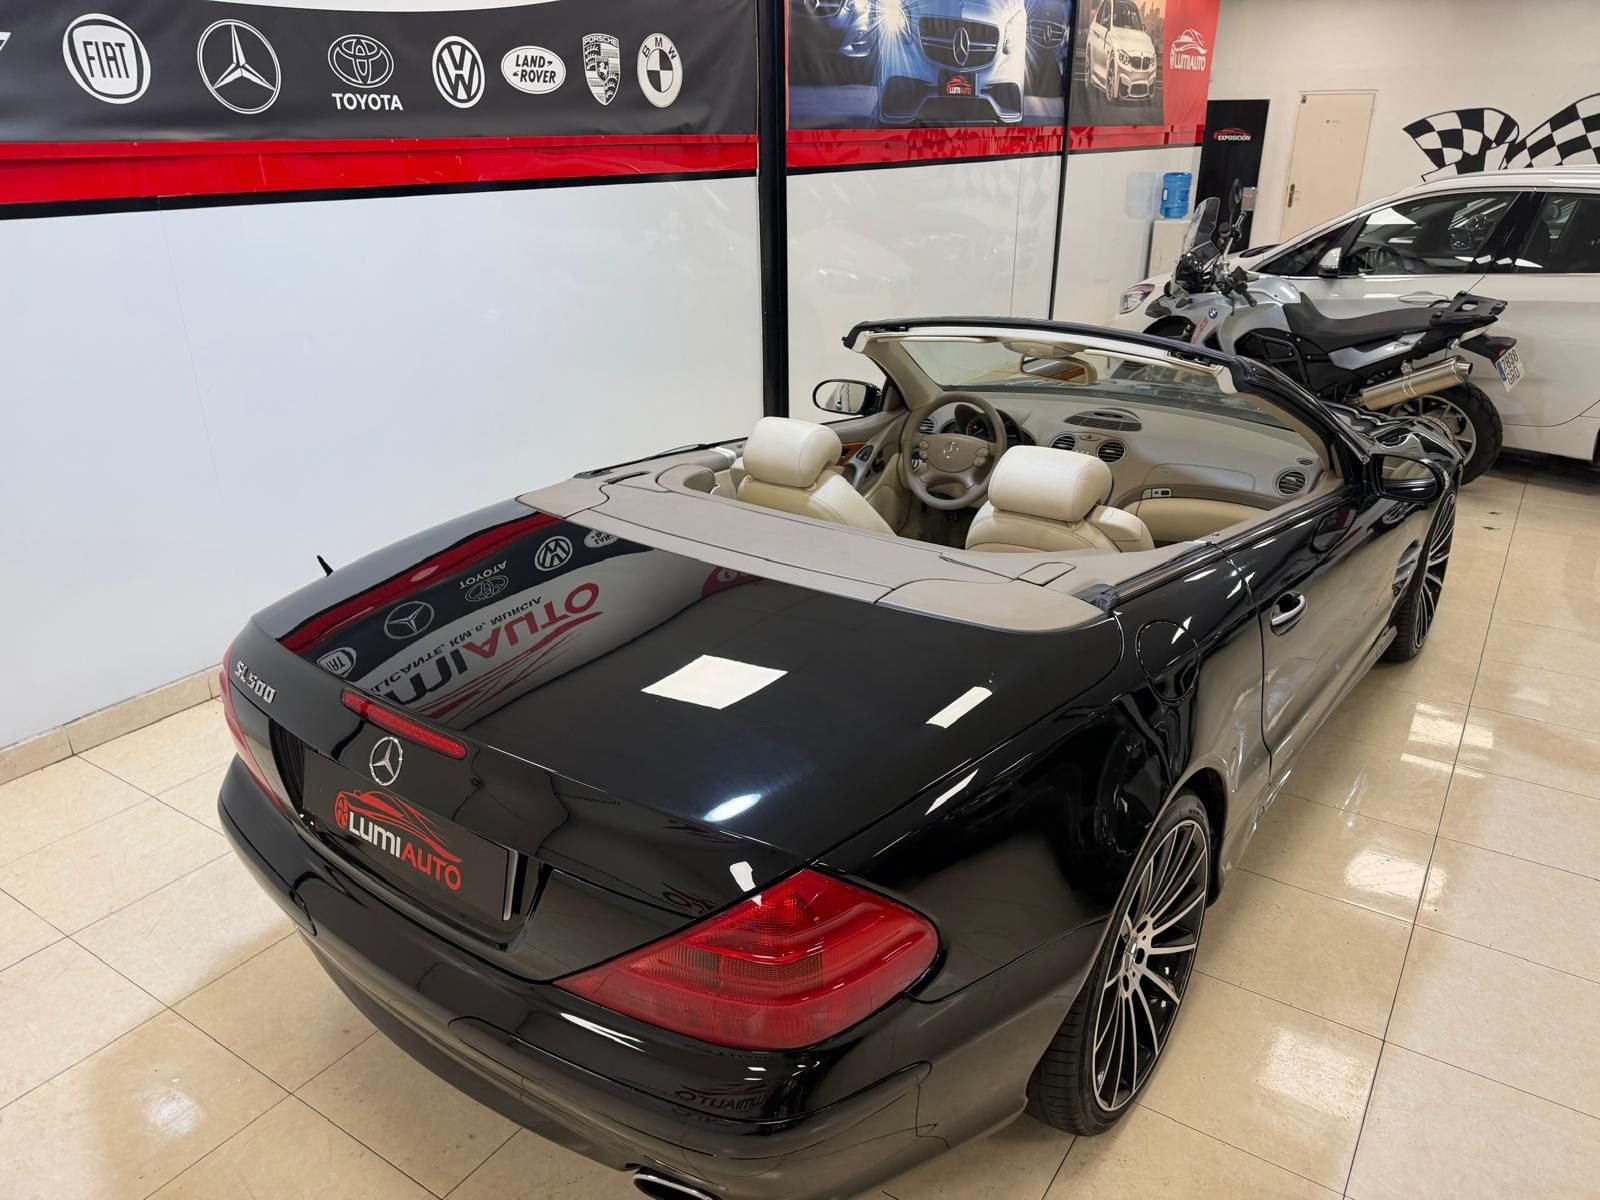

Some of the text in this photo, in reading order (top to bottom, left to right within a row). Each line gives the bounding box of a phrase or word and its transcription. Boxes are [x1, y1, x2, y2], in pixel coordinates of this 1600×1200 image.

[583, 35, 619, 49] PORSCHE
[82, 40, 130, 79] FIAT
[515, 54, 546, 69] LAND
[519, 69, 557, 84] ROVER
[331, 92, 404, 111] TOYOTA
[1217, 133, 1251, 141] EXPOSICIÓN
